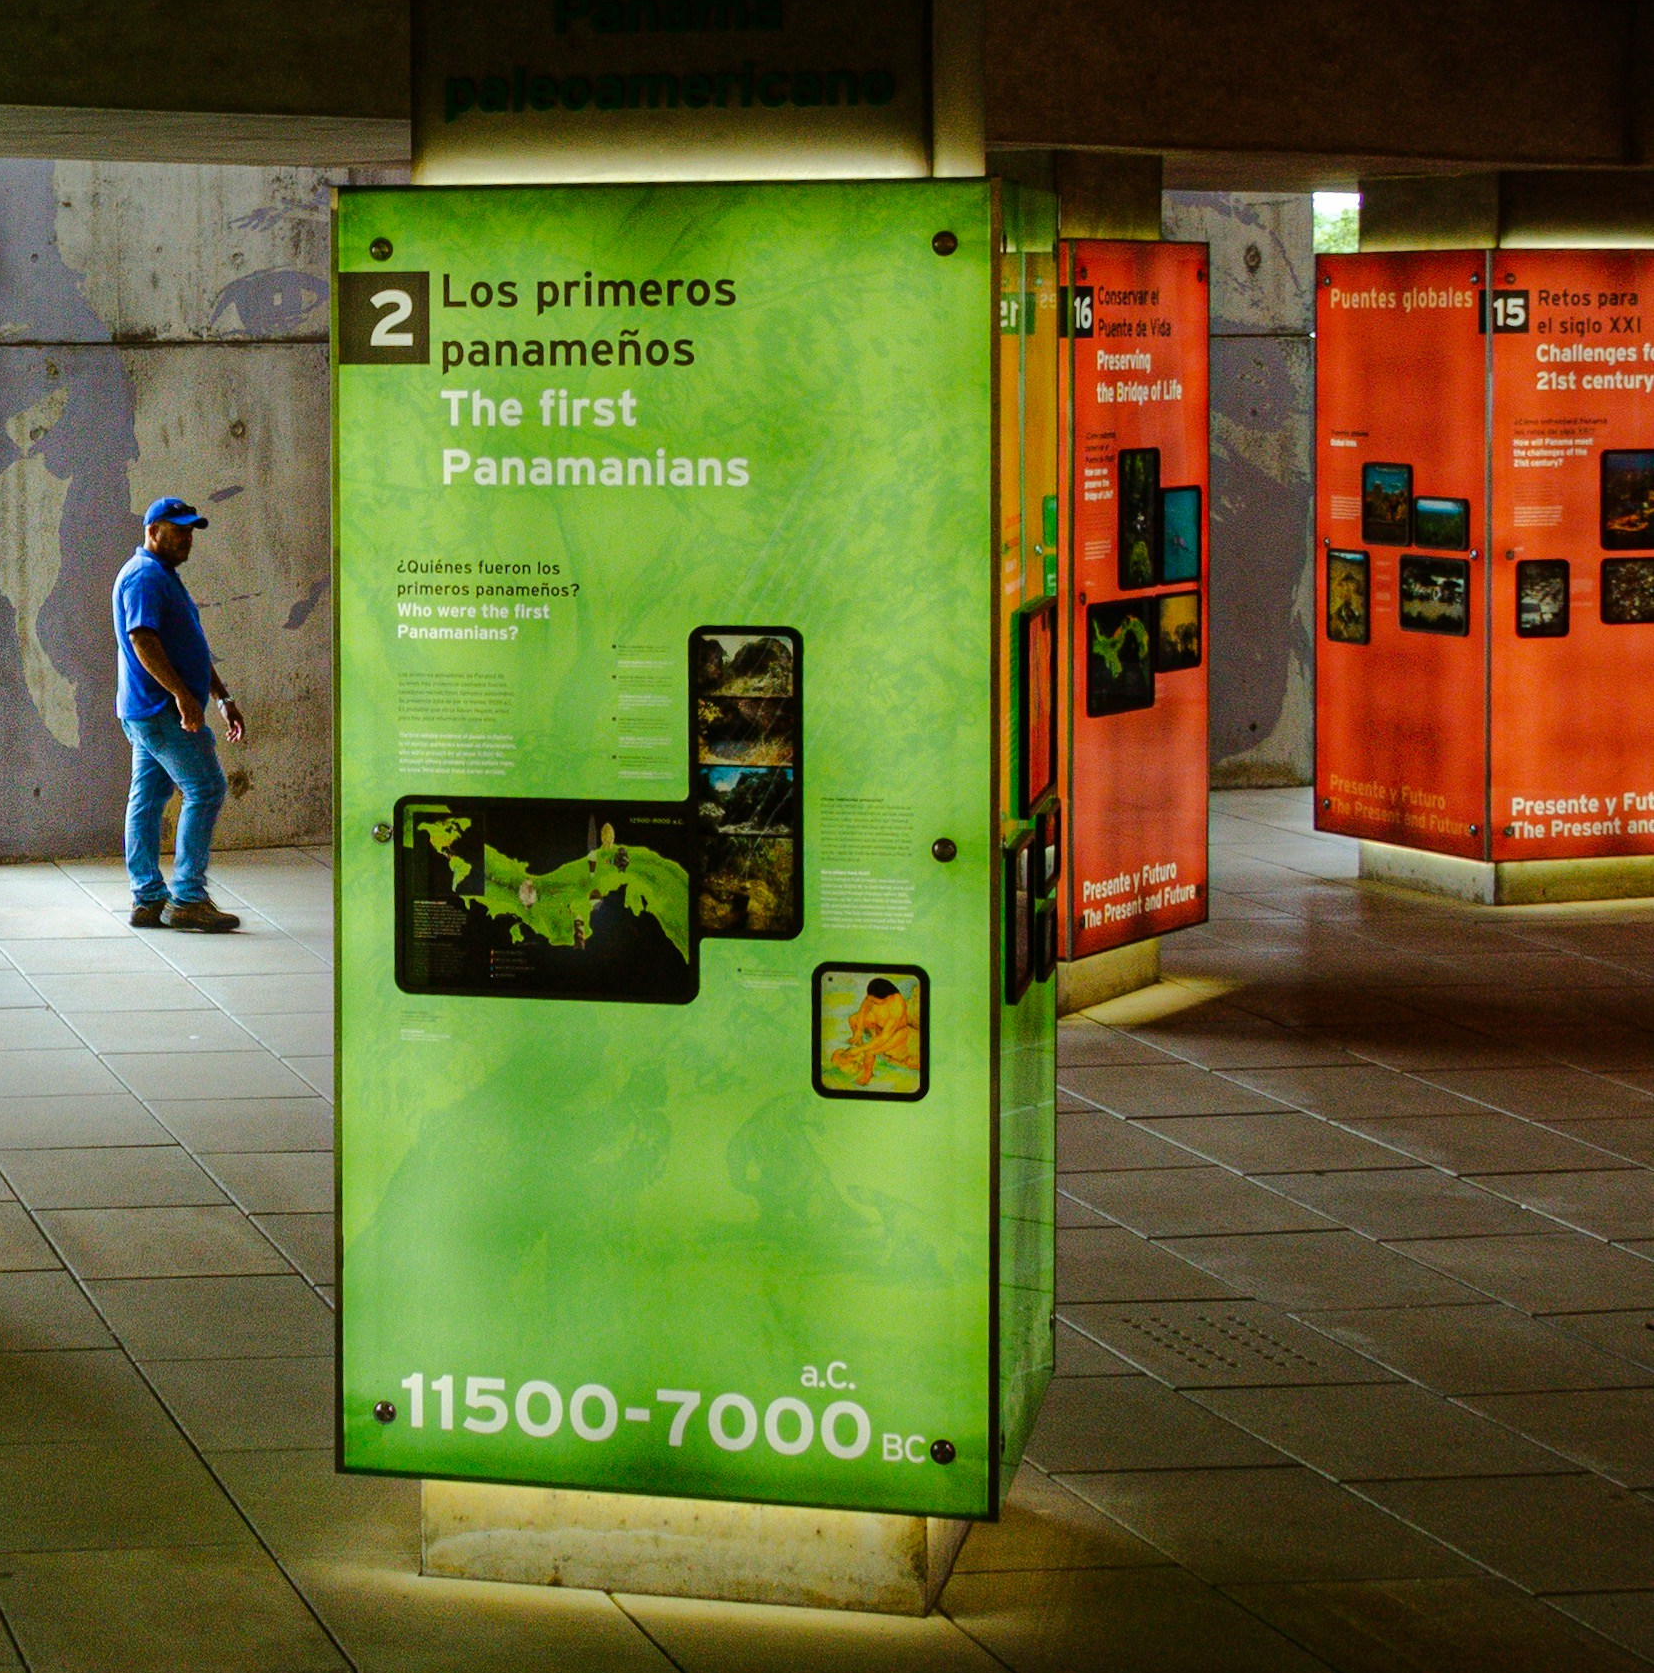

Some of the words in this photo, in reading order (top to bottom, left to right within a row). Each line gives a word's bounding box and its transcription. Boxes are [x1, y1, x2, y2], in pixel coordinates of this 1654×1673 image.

[444, 61, 895, 122] paleoamericano
[443, 274, 517, 308] Los
[538, 272, 736, 314] primeros
[1098, 286, 1149, 306] Conservar
[1151, 287, 1160, 306] el
[1330, 288, 1397, 309] Puentes
[1402, 286, 1473, 313] globales
[1538, 288, 1592, 306] Retos
[1598, 292, 1639, 309] para
[371, 290, 413, 346] 2
[1074, 296, 1092, 330] 16
[1493, 298, 1525, 326] 15
[1097, 319, 1132, 338] Puente
[1135, 319, 1148, 337] de
[1150, 317, 1172, 337] Vida
[1538, 317, 1552, 334] el
[1559, 316, 1602, 337] siglo
[1609, 316, 1642, 334] XXI
[443, 329, 694, 374] panameños
[1097, 349, 1151, 373] Preserving
[1535, 343, 1637, 366] Challenges
[1097, 381, 1114, 404] the
[1117, 379, 1149, 406] Bridge
[1151, 379, 1161, 402] of
[1163, 379, 1182, 402] Life
[1536, 371, 1577, 390] 21st
[1582, 370, 1654, 394] century
[440, 389, 522, 426] The
[540, 389, 637, 426] first
[441, 447, 749, 487] Panamanians
[397, 559, 472, 575] ¿Quiénes
[479, 560, 531, 575] fueron
[538, 561, 560, 575] los
[397, 582, 470, 597] primeros
[475, 581, 580, 598] panameños?
[397, 603, 432, 617] Who
[437, 606, 476, 618] were
[481, 604, 509, 618] the
[514, 604, 549, 619] first
[398, 623, 517, 640] Panamanians?
[1330, 775, 1386, 801] Presente
[1388, 785, 1397, 802] y
[1401, 785, 1446, 810] Futuro
[1511, 794, 1599, 816] Presente
[1605, 797, 1617, 817] y
[1330, 796, 1350, 816] The
[1354, 801, 1402, 825] Present
[1405, 809, 1426, 829] and
[1511, 821, 1545, 839] The
[1550, 816, 1621, 838] Present
[1083, 873, 1130, 903] Presente
[1132, 872, 1141, 891] y
[1142, 861, 1177, 886] Futuro
[1083, 906, 1102, 929] The
[1103, 898, 1143, 923] Present
[1145, 891, 1163, 912] and
[1163, 882, 1196, 907] Future
[801, 1361, 856, 1390] a.C.
[401, 1372, 871, 1460] 11500-7000
[883, 1433, 926, 1464] BC
